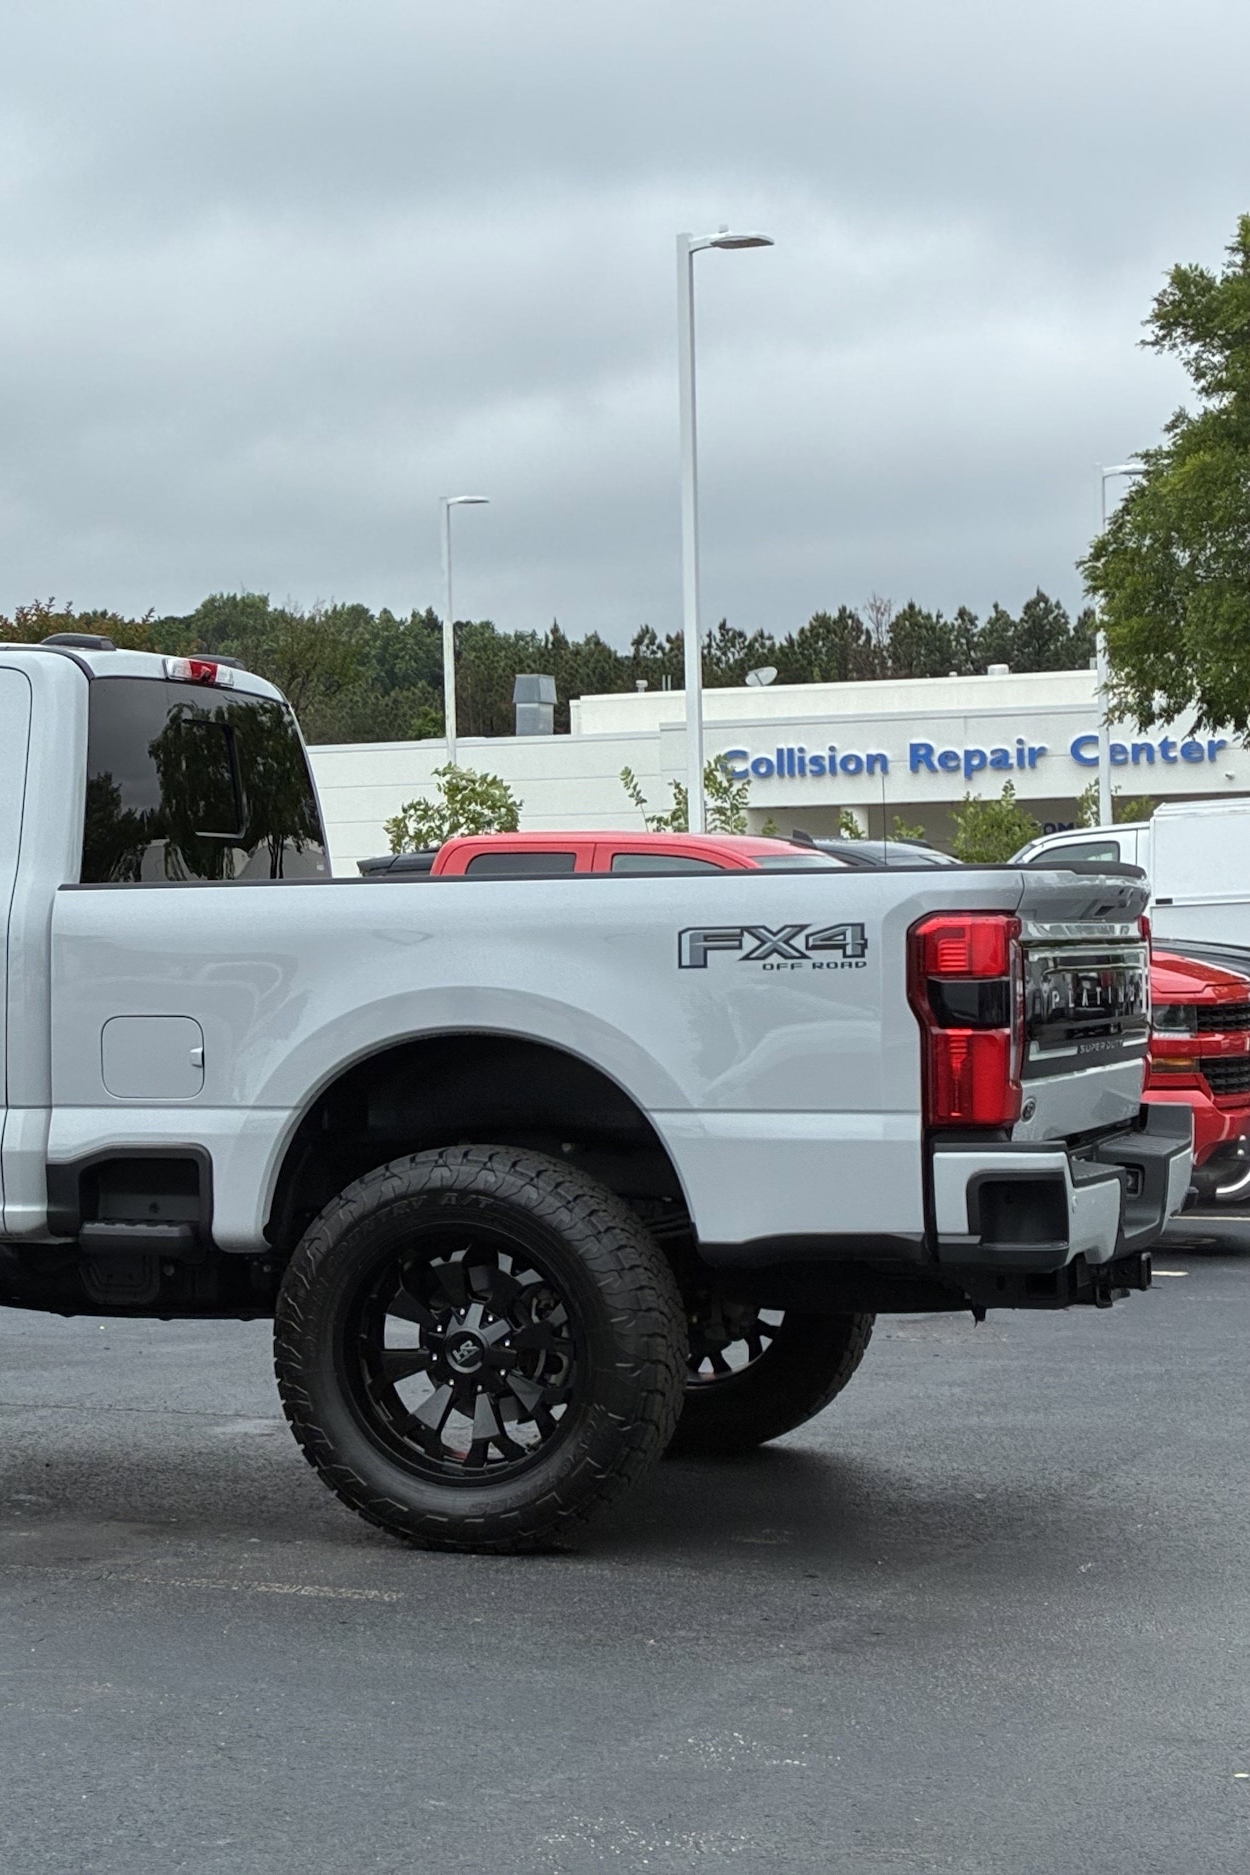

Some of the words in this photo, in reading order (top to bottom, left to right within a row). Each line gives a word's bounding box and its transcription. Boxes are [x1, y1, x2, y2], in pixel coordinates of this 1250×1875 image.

[721, 746, 889, 780] Collision
[909, 738, 1048, 781] Repair
[1070, 735, 1228, 767] Center
[678, 923, 868, 969] FX4
[762, 963, 804, 971] OFF
[812, 961, 868, 970] ROAD
[1052, 983, 1146, 1009] PLATIN
[441, 1193, 496, 1210] A/T
